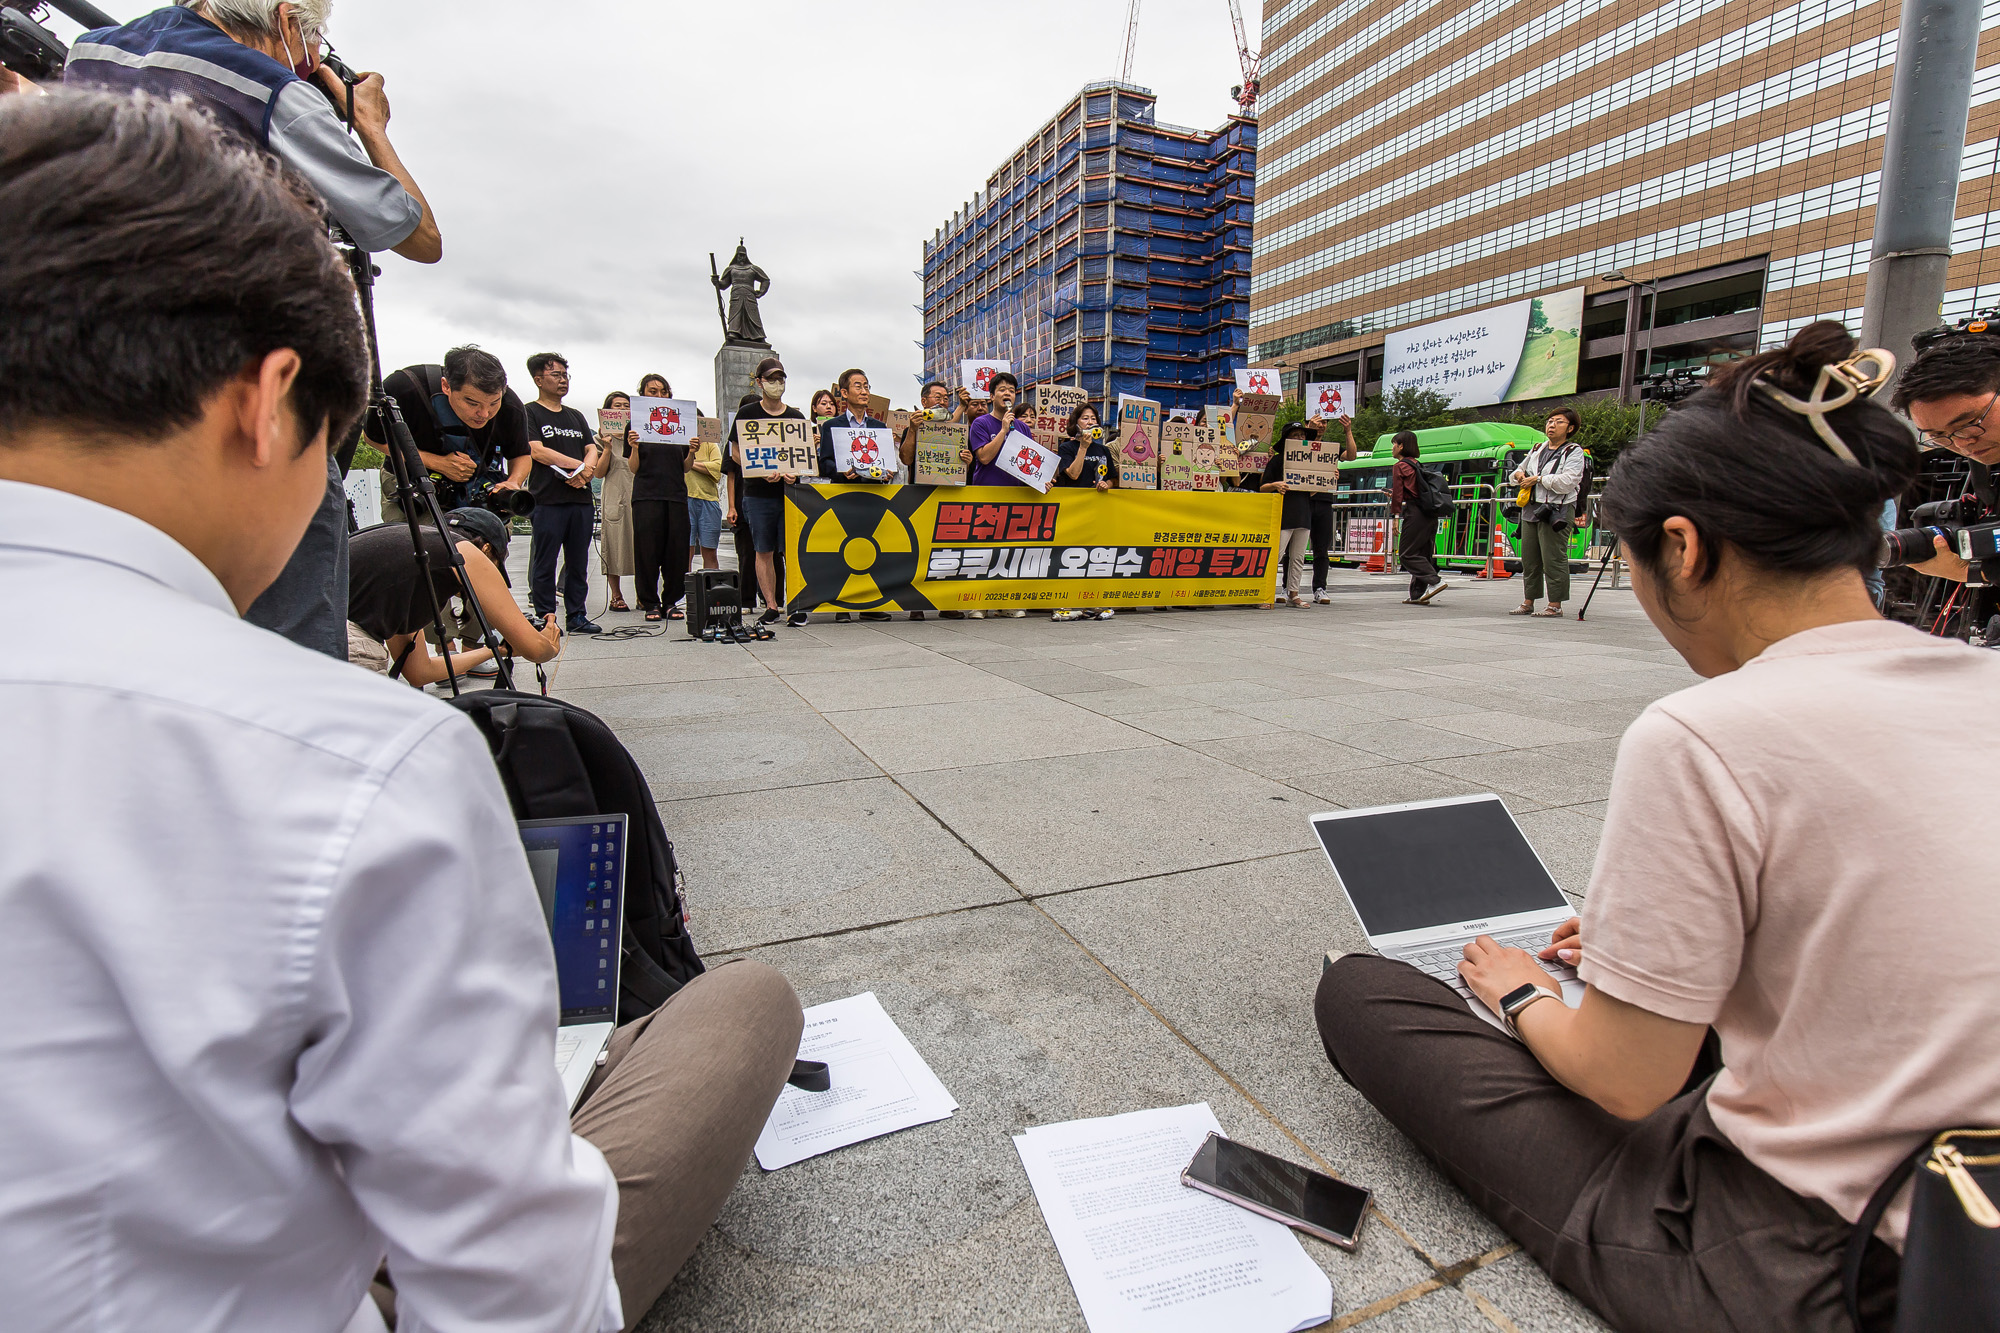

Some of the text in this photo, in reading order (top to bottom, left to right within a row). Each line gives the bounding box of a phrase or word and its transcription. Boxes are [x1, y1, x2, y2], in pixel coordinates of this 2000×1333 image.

[1406, 327, 1489, 353] 가고 있다는 사실만으로도
[1389, 349, 1477, 375] 어떤 시간은 반으로 접힌다
[1425, 372, 1440, 385] 다른
[1442, 368, 1465, 384] 풍경이
[1125, 403, 1156, 422] 바다
[1037, 417, 1057, 431] 즉각
[742, 420, 807, 445] 육지에
[1195, 428, 1215, 443] 방류
[1310, 441, 1322, 451] 왜
[745, 446, 815, 470] 보관하라
[1286, 450, 1339, 465] 바다에 버려?
[1469, 450, 1486, 458] 4591
[918, 465, 965, 475] 즉각 제소하라
[1122, 471, 1156, 483] 아니다
[1165, 465, 1177, 475] 투기
[1194, 474, 1218, 488] 멈춰!
[935, 503, 1058, 540] 멈춰라!
[1153, 532, 1271, 543] 환경운동연합 전국 동시 기자회견
[926, 547, 1269, 580] 후쿠시마 오염수 해양 투기!
[984, 592, 1009, 601] 2023년
[1010, 592, 1021, 600] 8월
[1022, 592, 1038, 600] 24일
[1039, 592, 1053, 600] 오전
[1055, 592, 1069, 600] 11시
[1102, 591, 1121, 599] 광화문
[1122, 590, 1141, 598] 이순신
[1141, 590, 1153, 598] 동상
[1154, 590, 1161, 598] 앞
[1192, 590, 1227, 598] 서울환경연합,
[1228, 589, 1260, 597] 환경운동연합
[709, 603, 738, 616] MIPRO
[1463, 922, 1489, 930] SAMSUNG
